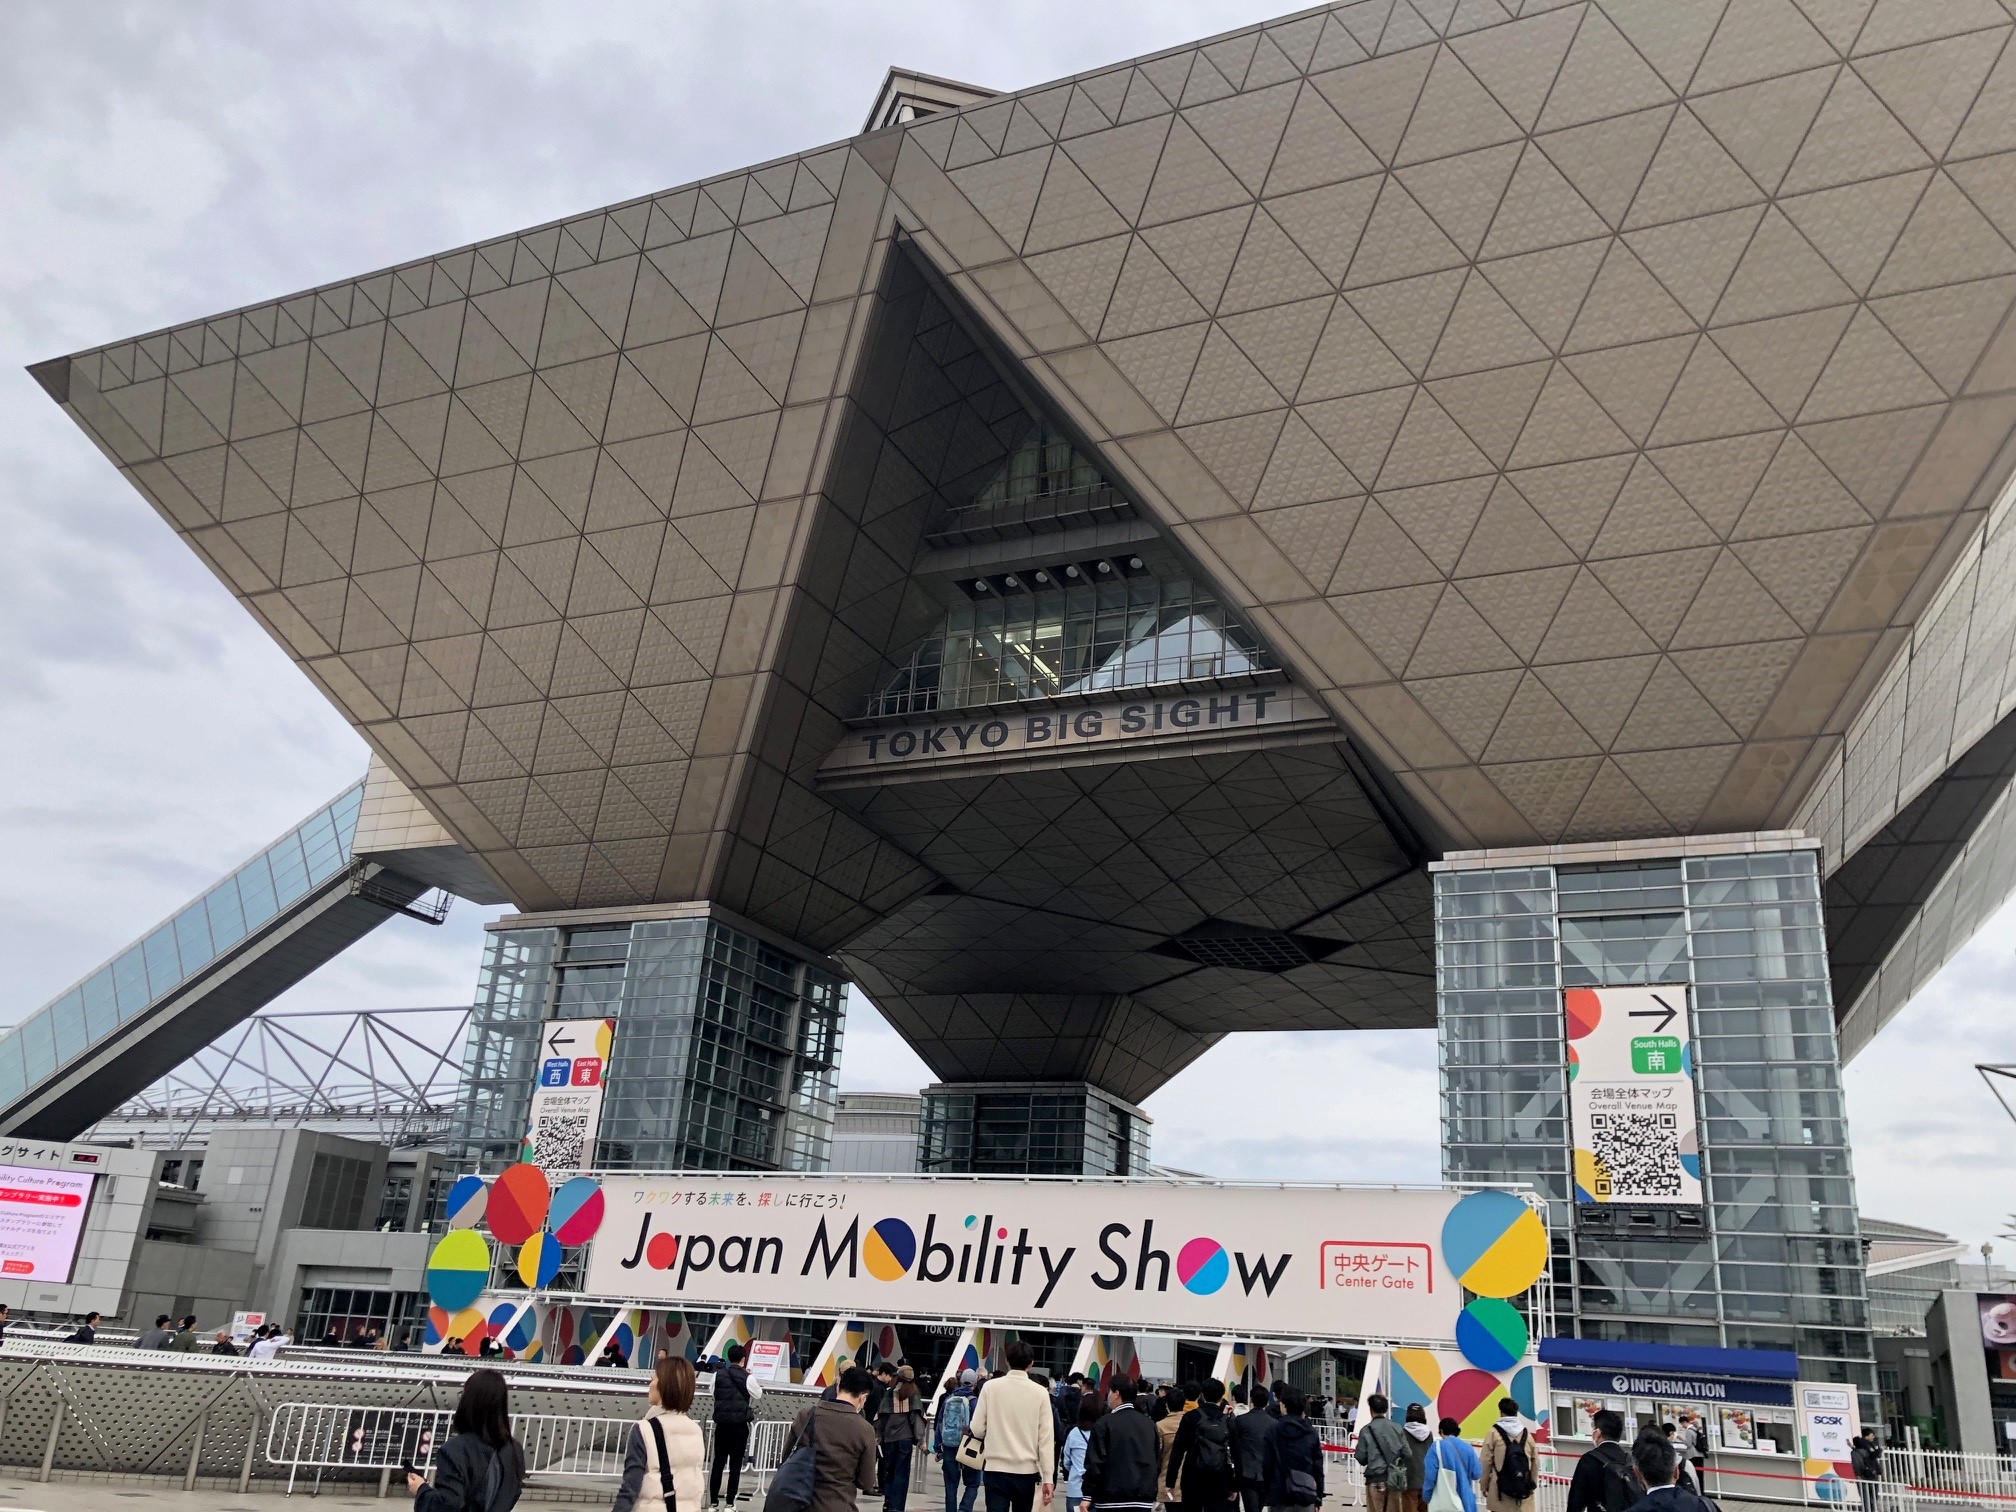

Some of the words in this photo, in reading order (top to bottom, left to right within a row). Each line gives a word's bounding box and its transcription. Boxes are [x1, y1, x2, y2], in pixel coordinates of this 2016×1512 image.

[862, 721, 1008, 760] TOKYO
[1026, 711, 1102, 743] BIG
[1121, 691, 1276, 733] SIGHT
[1634, 1040, 1657, 1049] South
[1658, 1039, 1677, 1048] Halls
[558, 1060, 569, 1068] Halls
[1647, 1050, 1666, 1071] 南
[549, 1069, 562, 1085] 西
[580, 1068, 593, 1083] 東
[1590, 1086, 1674, 1099] 会場全体マップ
[543, 1095, 591, 1106] 会場全体マップ
[1589, 1101, 1622, 1110] Overall
[1625, 1101, 1653, 1110] Venue
[1656, 1102, 1678, 1111] Map
[0, 1173, 15, 1183] ility
[18, 1176, 44, 1185] Culture
[46, 1178, 83, 1188] Program
[634, 1191, 846, 1209] ワクワクする未来を、探しに行こう!
[621, 1212, 783, 1290] Japan
[800, 1213, 1077, 1308] Mobility
[1091, 1219, 1293, 1298] Show
[1334, 1253, 1419, 1273] 中央ゲート
[1335, 1273, 1377, 1287] Center
[1382, 1275, 1414, 1289] Gate
[1630, 1377, 1725, 1398] INFORMATION
[1814, 1416, 1842, 1425] SCSK
